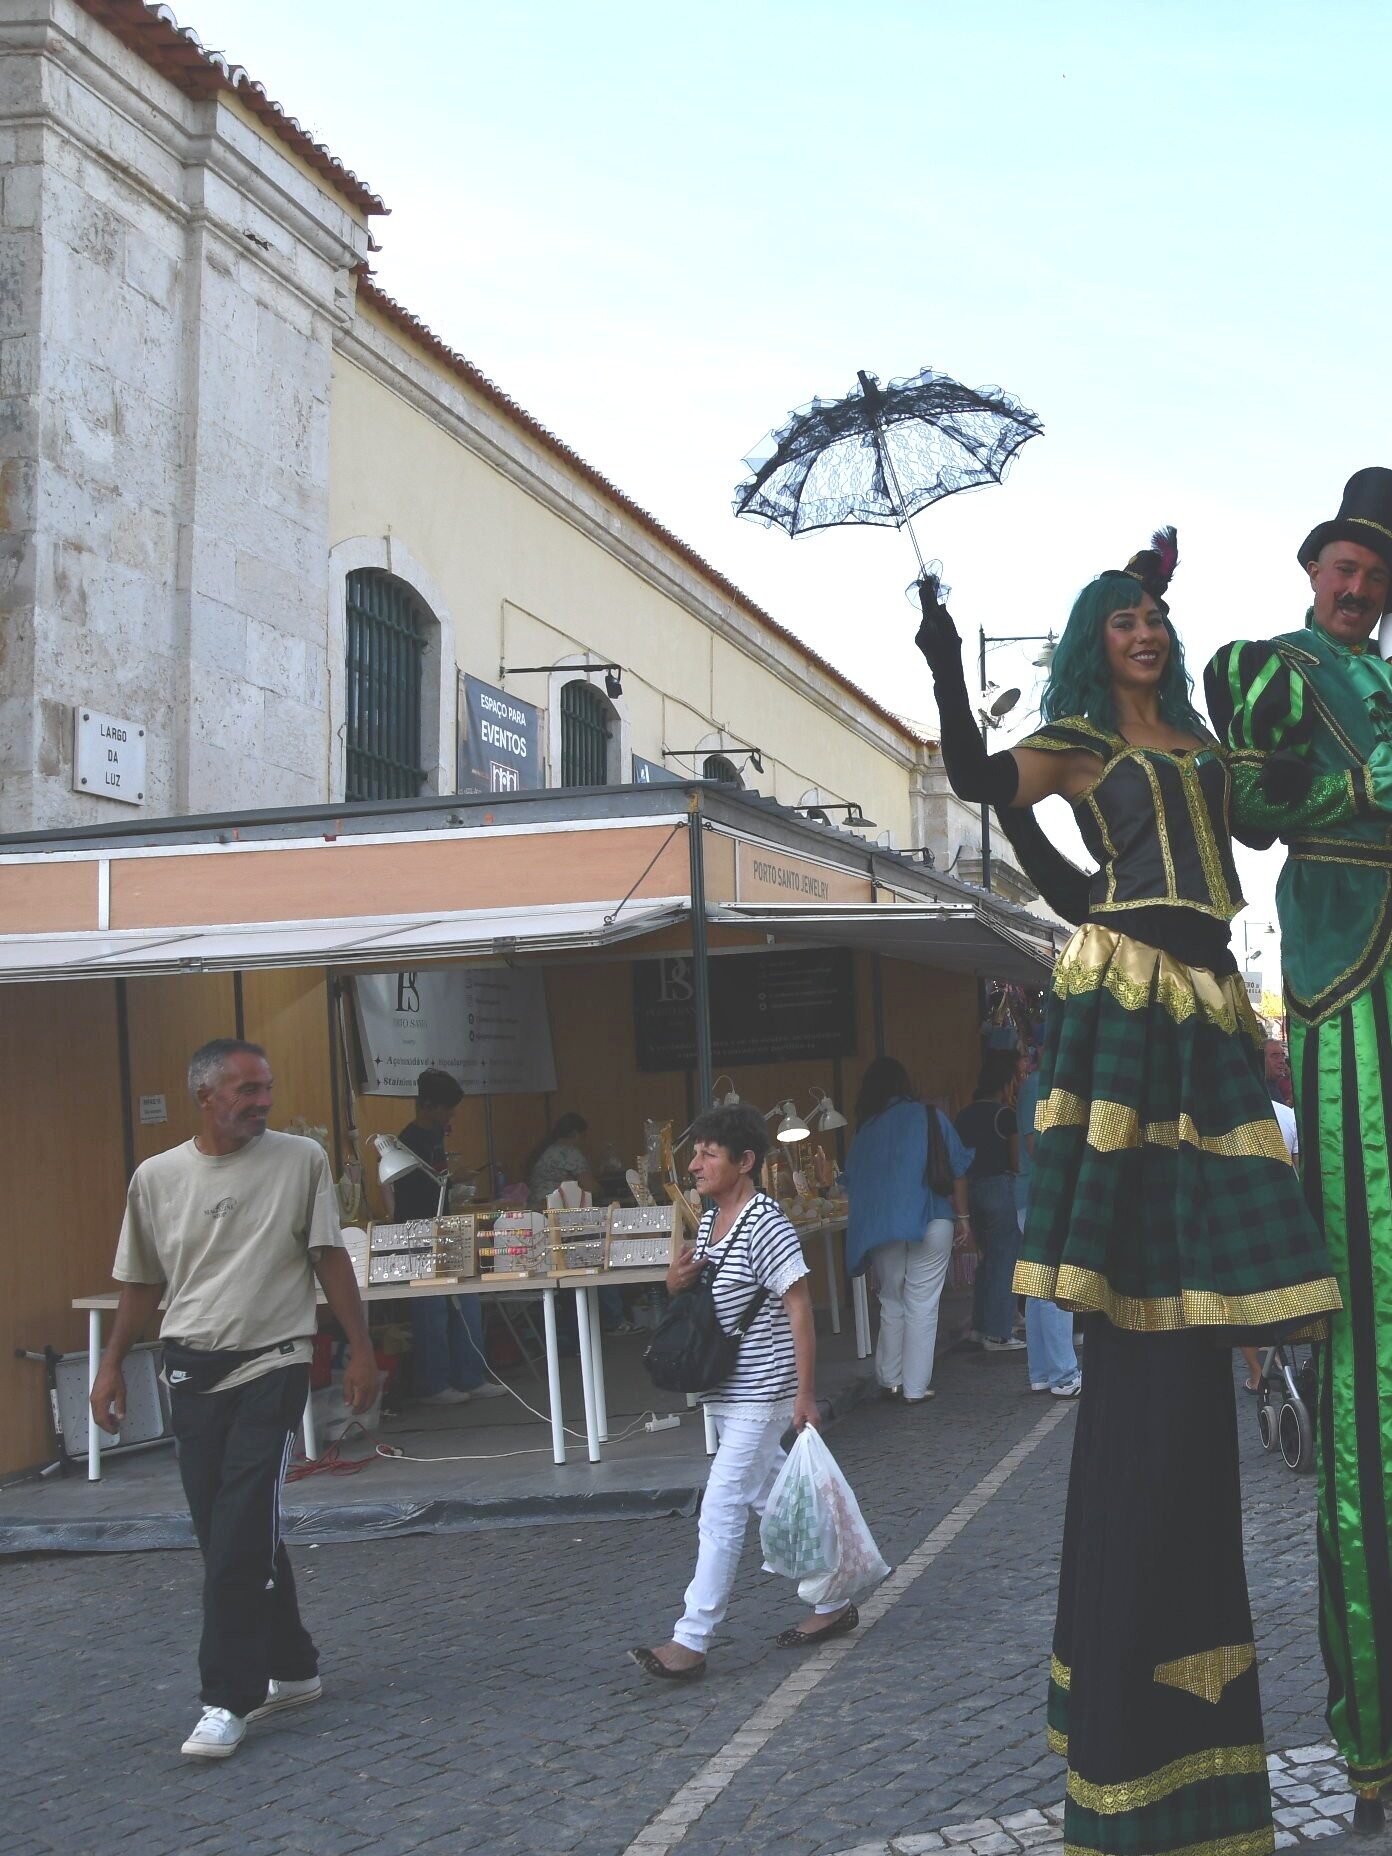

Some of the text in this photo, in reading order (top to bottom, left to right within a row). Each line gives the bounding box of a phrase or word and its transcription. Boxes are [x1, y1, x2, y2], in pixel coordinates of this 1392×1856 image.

[480, 693, 527, 727] ESPAÇO PARA
[100, 723, 127, 743] LARGO
[481, 720, 527, 758] EVENTOS
[107, 749, 119, 764] DA
[105, 771, 121, 787] LUZ
[753, 860, 829, 901] PORTO SANTO JEWELRY
